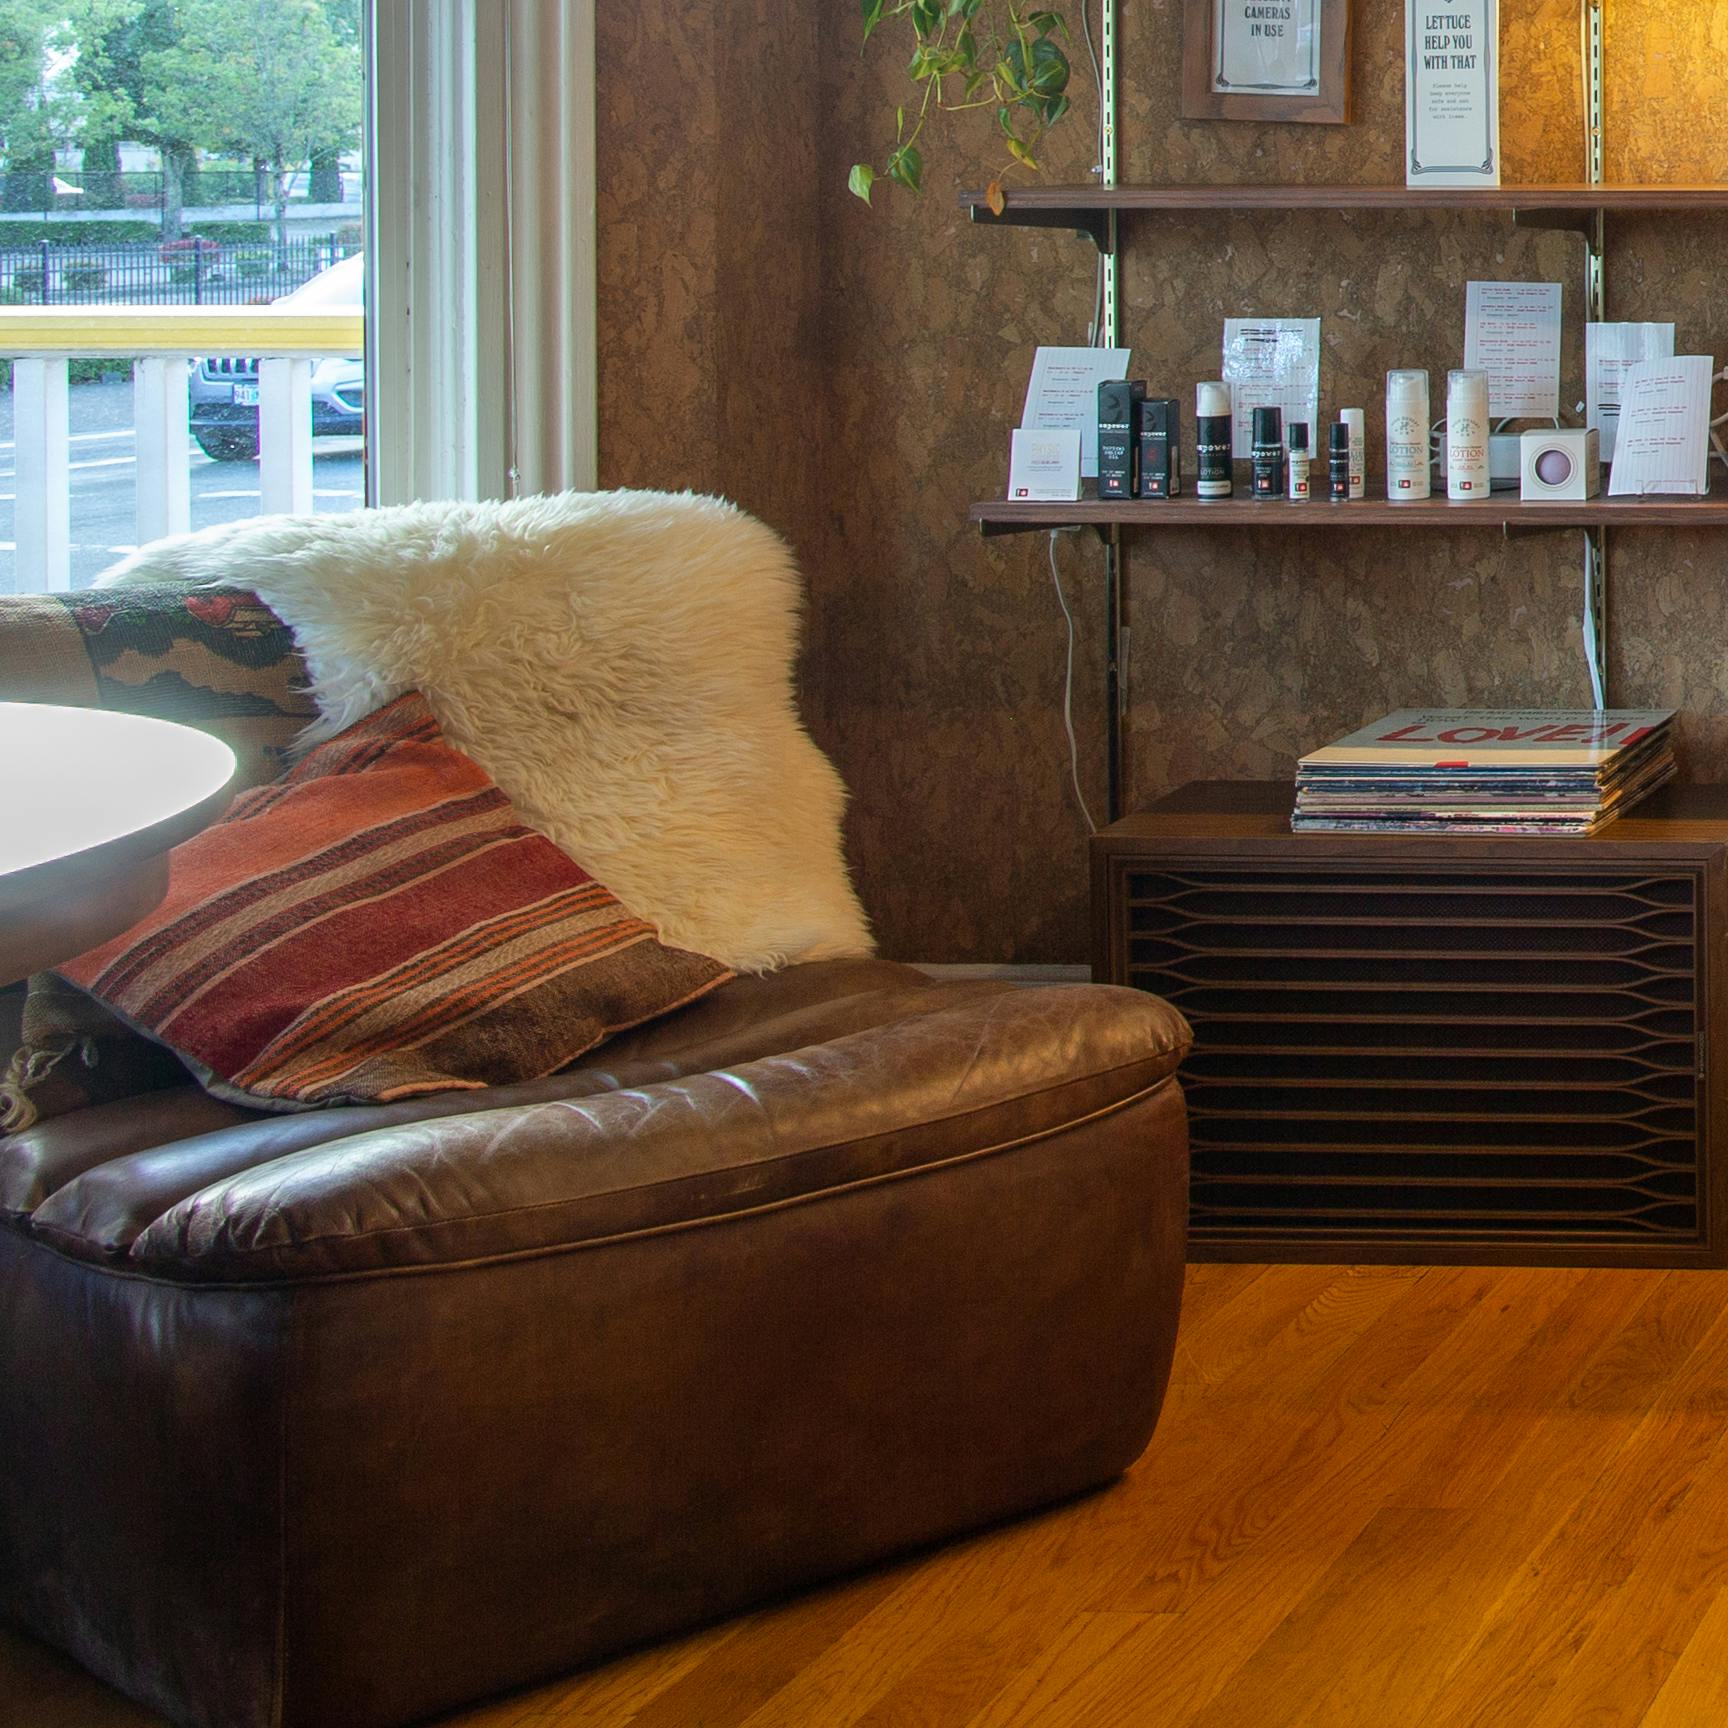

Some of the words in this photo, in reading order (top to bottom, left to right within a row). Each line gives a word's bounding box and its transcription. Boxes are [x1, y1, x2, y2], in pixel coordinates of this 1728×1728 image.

[1244, 6, 1291, 19] CAMERAS
[1426, 14, 1471, 30] LETTUCE
[1250, 24, 1262, 37] IN
[1265, 24, 1284, 37] USE
[1424, 35, 1450, 50] HELP
[1452, 34, 1473, 49] YOU
[1424, 56, 1449, 70] WITH
[1450, 55, 1477, 70] THAT
